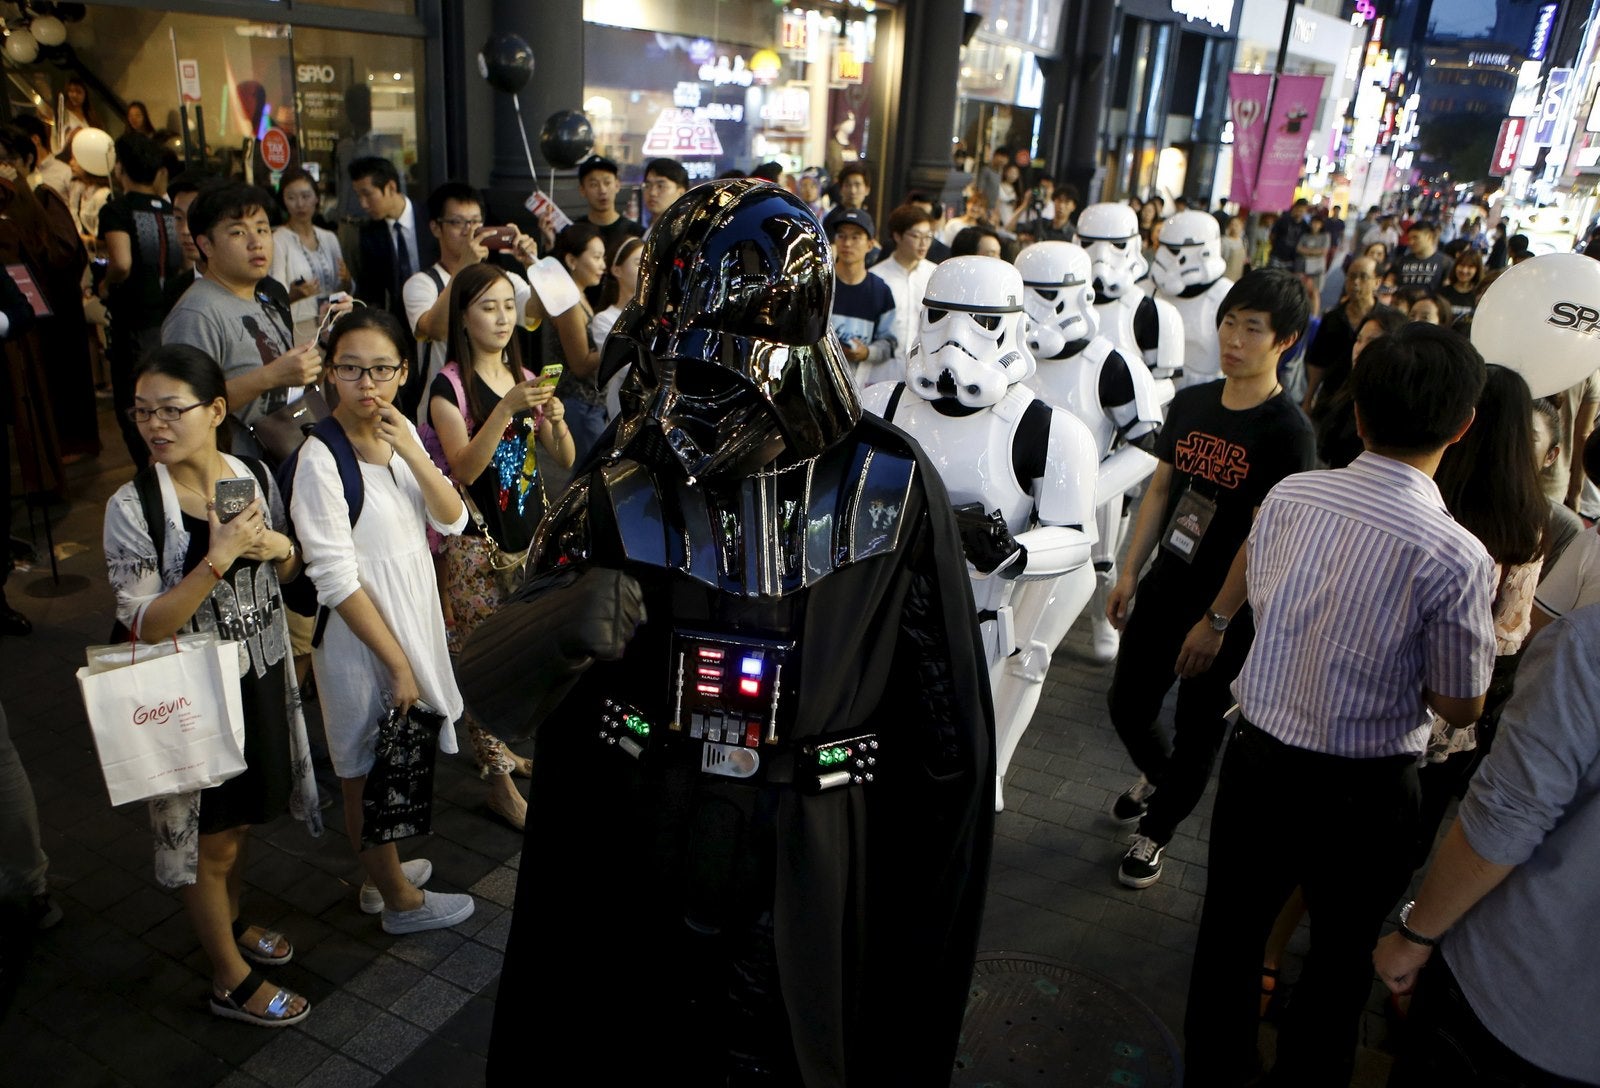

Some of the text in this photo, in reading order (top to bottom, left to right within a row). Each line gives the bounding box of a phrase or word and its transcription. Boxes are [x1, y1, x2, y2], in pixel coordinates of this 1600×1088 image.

[297, 64, 334, 83] SPAO
[267, 142, 284, 154] TAX
[646, 124, 718, 150] 금요일
[1177, 431, 1250, 470] STAR
[1175, 448, 1247, 489] WARS
